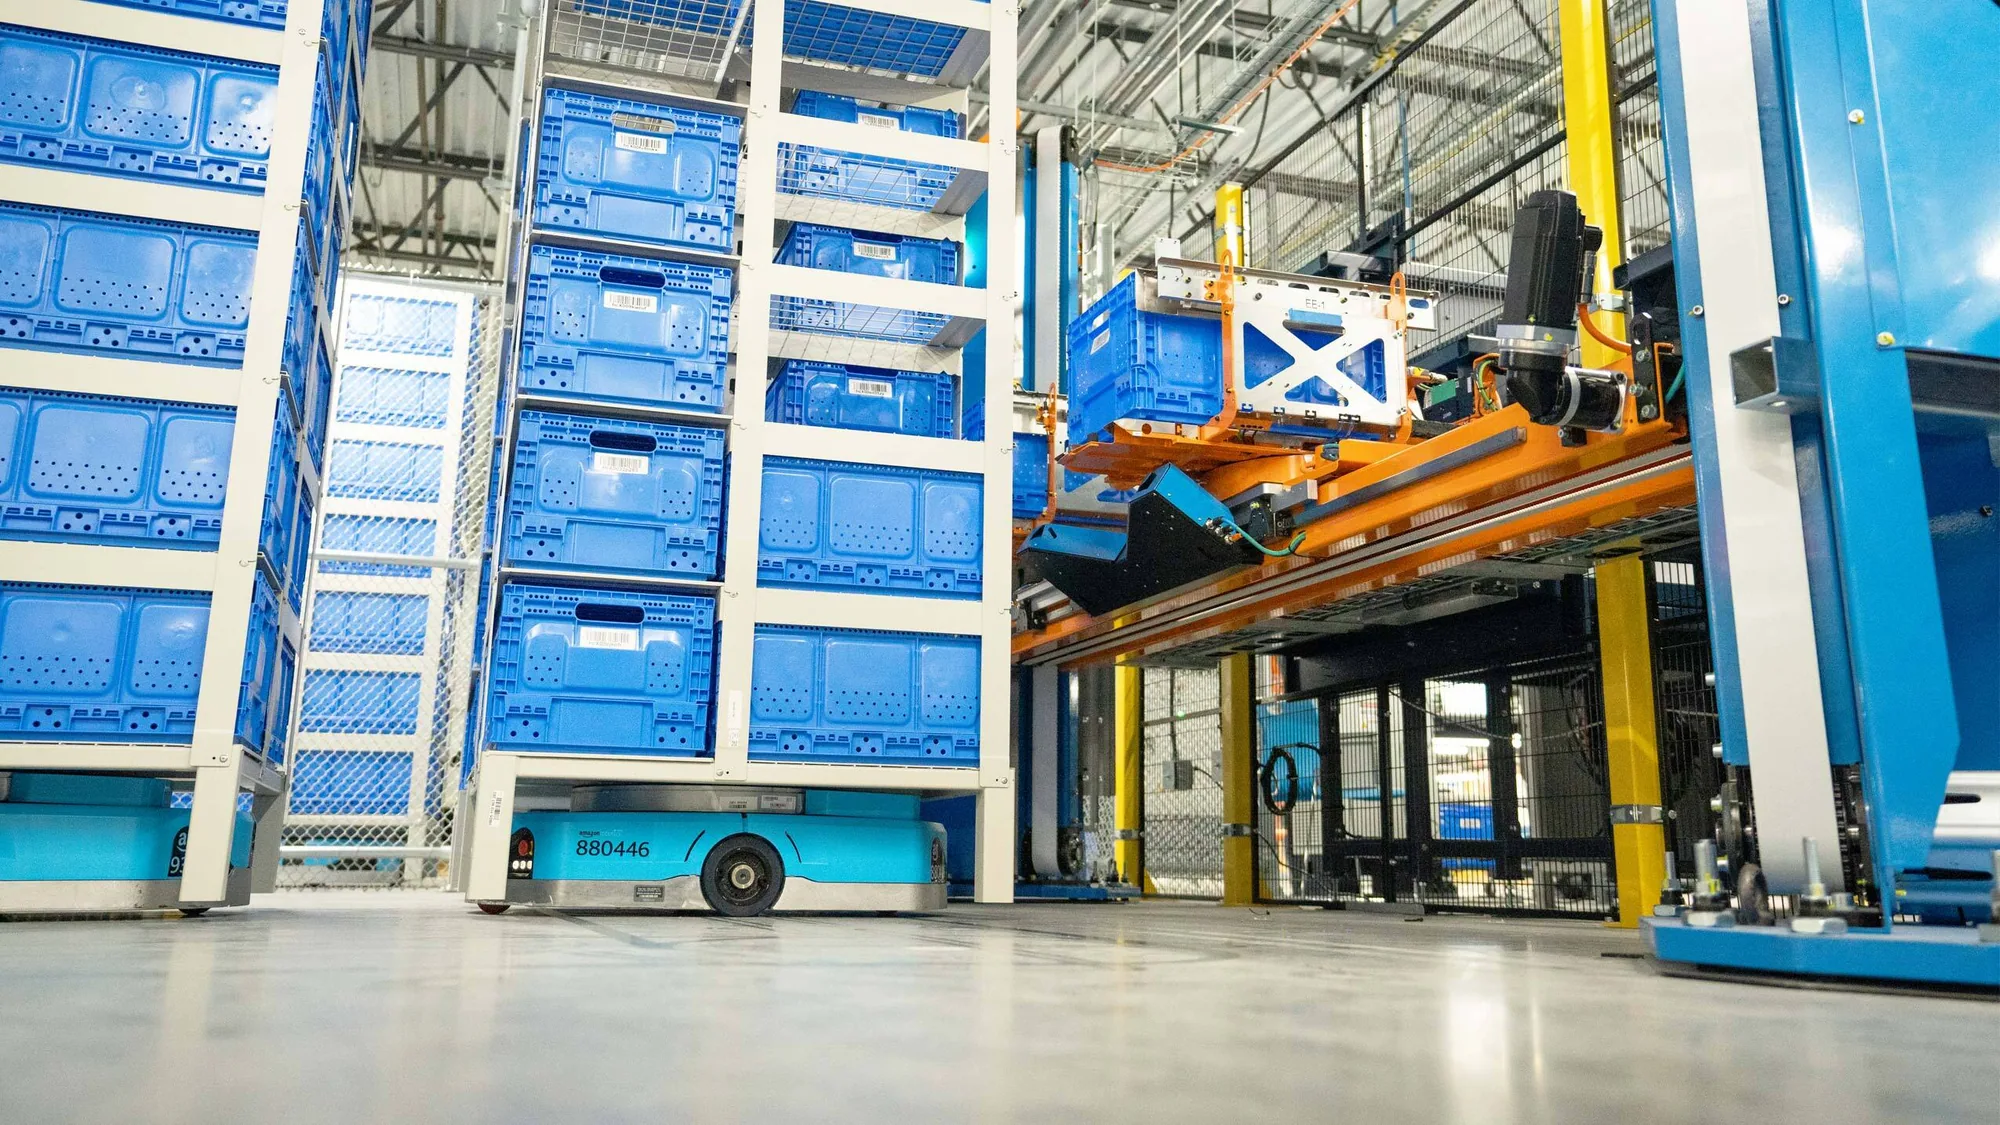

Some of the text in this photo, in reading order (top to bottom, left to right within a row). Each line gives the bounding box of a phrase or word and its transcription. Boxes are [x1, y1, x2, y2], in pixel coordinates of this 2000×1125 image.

[1305, 298, 1325, 310] EE-1
[579, 830, 601, 838] amazon
[576, 839, 650, 858] 880446
